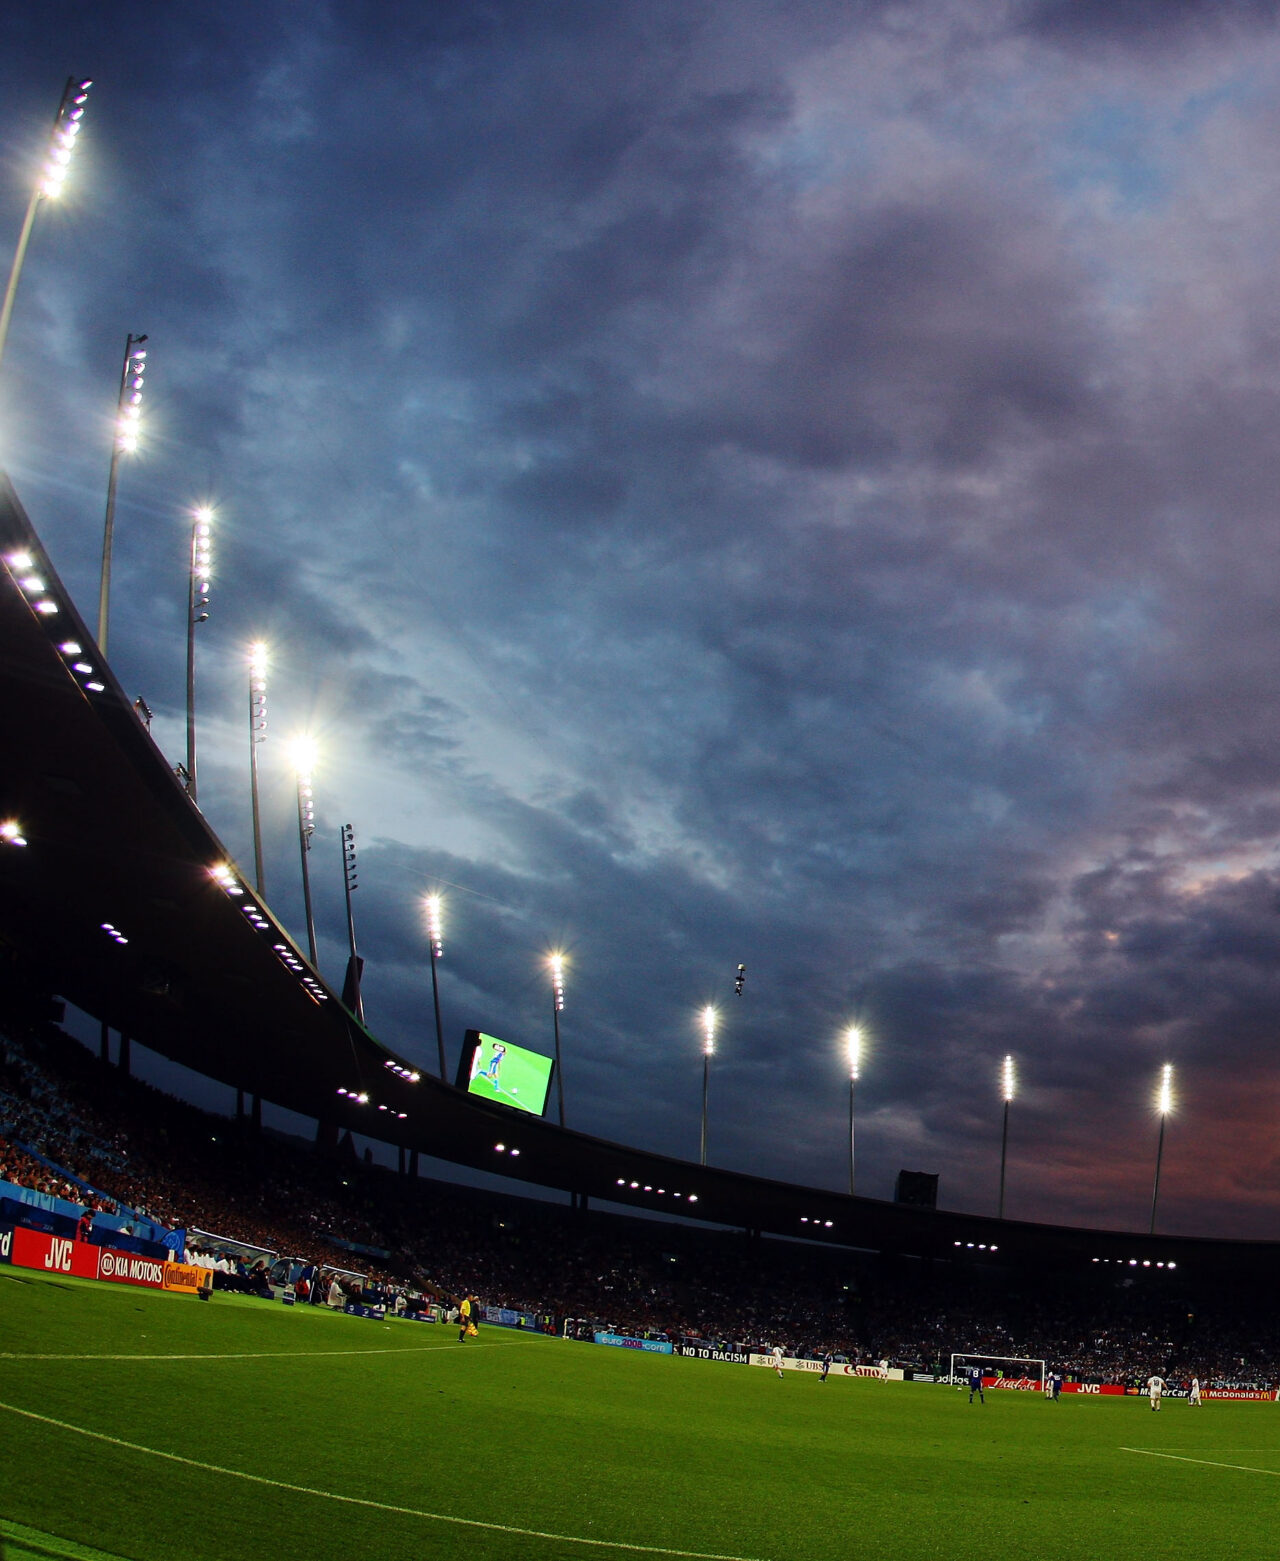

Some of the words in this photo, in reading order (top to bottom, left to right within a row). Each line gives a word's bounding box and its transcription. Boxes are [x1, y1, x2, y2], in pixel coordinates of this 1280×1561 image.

[45, 1237, 73, 1271] JVC
[115, 1256, 128, 1277] KIA
[130, 1259, 163, 1283] MOTORS
[165, 1263, 198, 1288] Continental
[682, 1346, 695, 1357] NO
[697, 1348, 709, 1359] TO
[712, 1350, 747, 1364] RACISM
[806, 1361, 824, 1371] UBS
[973, 1369, 979, 1378] 8
[1077, 1383, 1100, 1394] JVC
[1209, 1391, 1260, 1399] McDonald's
